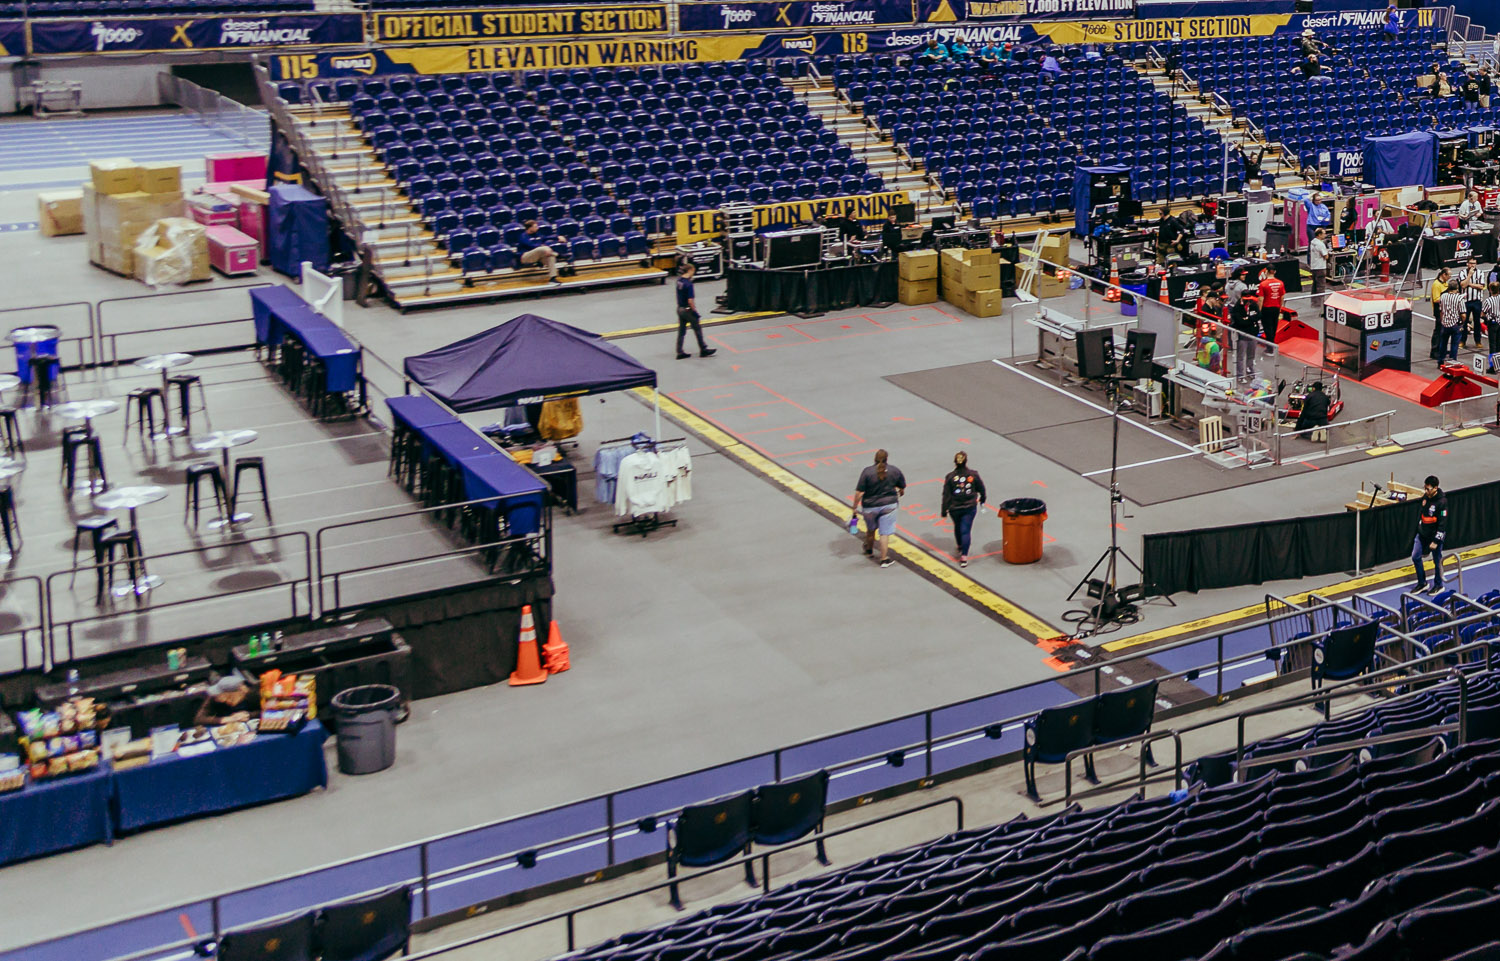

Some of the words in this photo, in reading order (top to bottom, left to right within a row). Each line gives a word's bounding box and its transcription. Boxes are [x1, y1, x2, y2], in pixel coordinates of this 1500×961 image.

[812, 2, 845, 12] desert
[1028, 0, 1059, 14] 7,000
[1060, 0, 1074, 12] FT
[384, 15, 478, 38] OFFICIAL
[482, 11, 576, 35] STUDENT
[581, 9, 663, 31] SECTION
[821, 10, 876, 24] FINANCIAL
[1302, 14, 1338, 28] desert
[1418, 9, 1434, 27] 111
[222, 18, 270, 31] desert
[1081, 23, 1107, 41] 7000
[1114, 20, 1184, 41] STUDENT
[1188, 17, 1251, 38] SECTION
[237, 28, 313, 44] FINANCIAL
[842, 32, 868, 53] 113
[886, 31, 933, 47] desert
[944, 25, 1024, 44] FINANCIAL
[785, 39, 813, 49] NAU
[467, 43, 590, 71] ELEVATION
[596, 39, 699, 65] WARNING
[280, 54, 319, 79] 115
[333, 57, 372, 69] NAU
[1454, 248, 1473, 259] FIRST
[1182, 289, 1201, 298] FIRST
